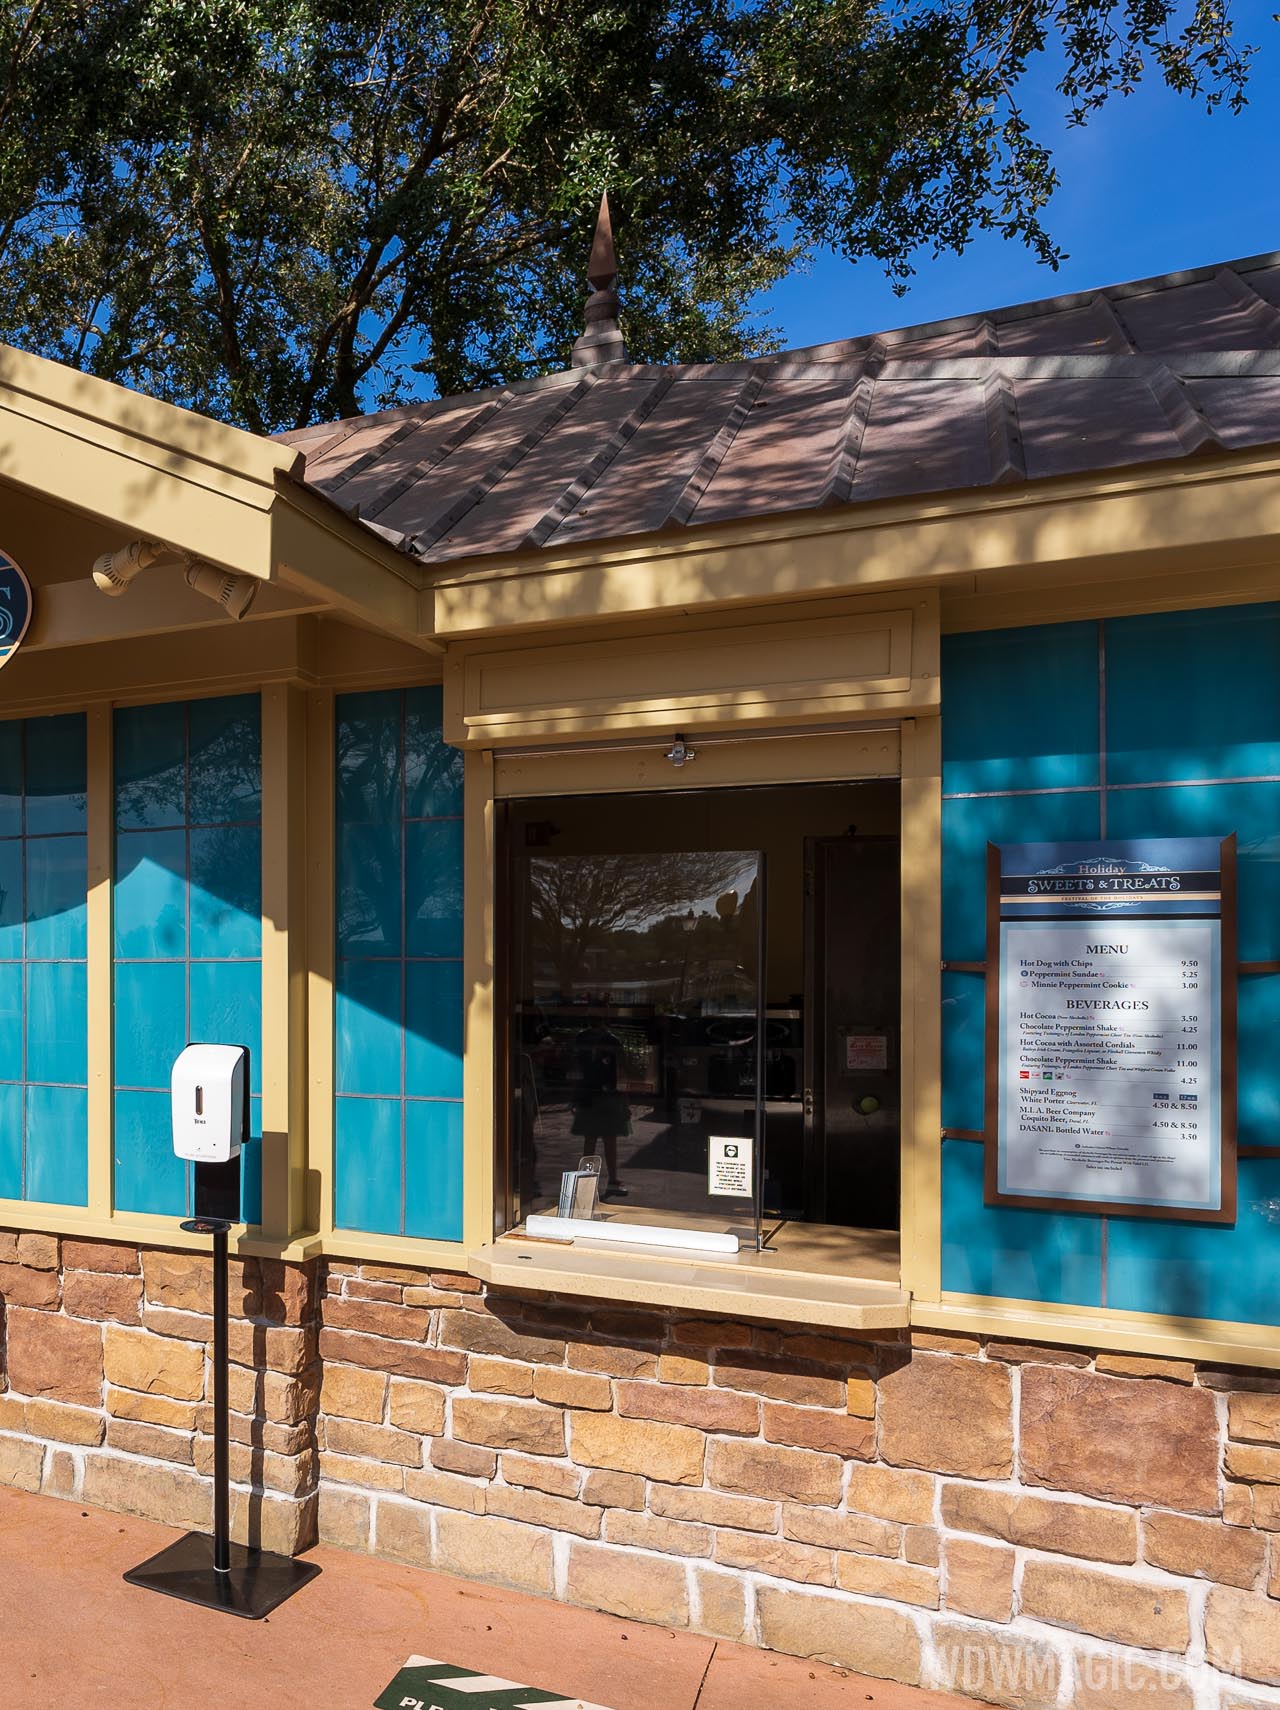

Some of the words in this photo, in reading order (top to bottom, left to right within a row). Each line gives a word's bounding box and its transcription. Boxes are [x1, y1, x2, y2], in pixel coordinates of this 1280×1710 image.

[1079, 864, 1127, 876] Holiday
[1027, 879, 1095, 894] SWEETS
[1098, 880, 1109, 889] &
[1110, 876, 1181, 891] TREATS
[1086, 944, 1129, 954] MENU
[1020, 960, 1035, 968] Hot
[1035, 960, 1051, 970] Dog
[1052, 960, 1070, 968] with
[1071, 960, 1093, 971] Chips
[1181, 960, 1198, 968] 9.50
[1029, 970, 1071, 981] Peppermint
[1072, 970, 1099, 978] Sundae
[1182, 971, 1198, 979] 5.25
[1031, 981, 1057, 989] Minnie
[1058, 981, 1101, 992] Peppermint
[1102, 981, 1129, 989] Cookie
[1181, 982, 1198, 990] 3.00
[1066, 999, 1149, 1010] BEVERAGES
[1020, 1012, 1034, 1020] Hot
[1035, 1012, 1056, 1020] Cocoa
[1056, 1023, 1095, 1033] Peppermint
[1096, 1024, 1118, 1032] Shake
[1105, 1041, 1135, 1049] Cordials
[1176, 1043, 1198, 1051] 11.00
[1020, 1055, 1054, 1063] Chocolate
[1056, 1056, 1095, 1065] Peppermint
[1096, 1057, 1118, 1065] Shake
[1176, 1060, 1198, 1068] 11.00
[1019, 1088, 1049, 1097] Shipyard
[1050, 1089, 1077, 1098] Eggnog
[1021, 1096, 1043, 1104] White
[1180, 1103, 1198, 1111] 8.50
[1046, 1107, 1061, 1115] Beer
[1062, 1108, 1096, 1118] Company
[1021, 1114, 1049, 1123] Coquito
[1050, 1115, 1068, 1123] Beer,
[1081, 1127, 1105, 1136] Water
[1180, 1133, 1198, 1141] 3.50
